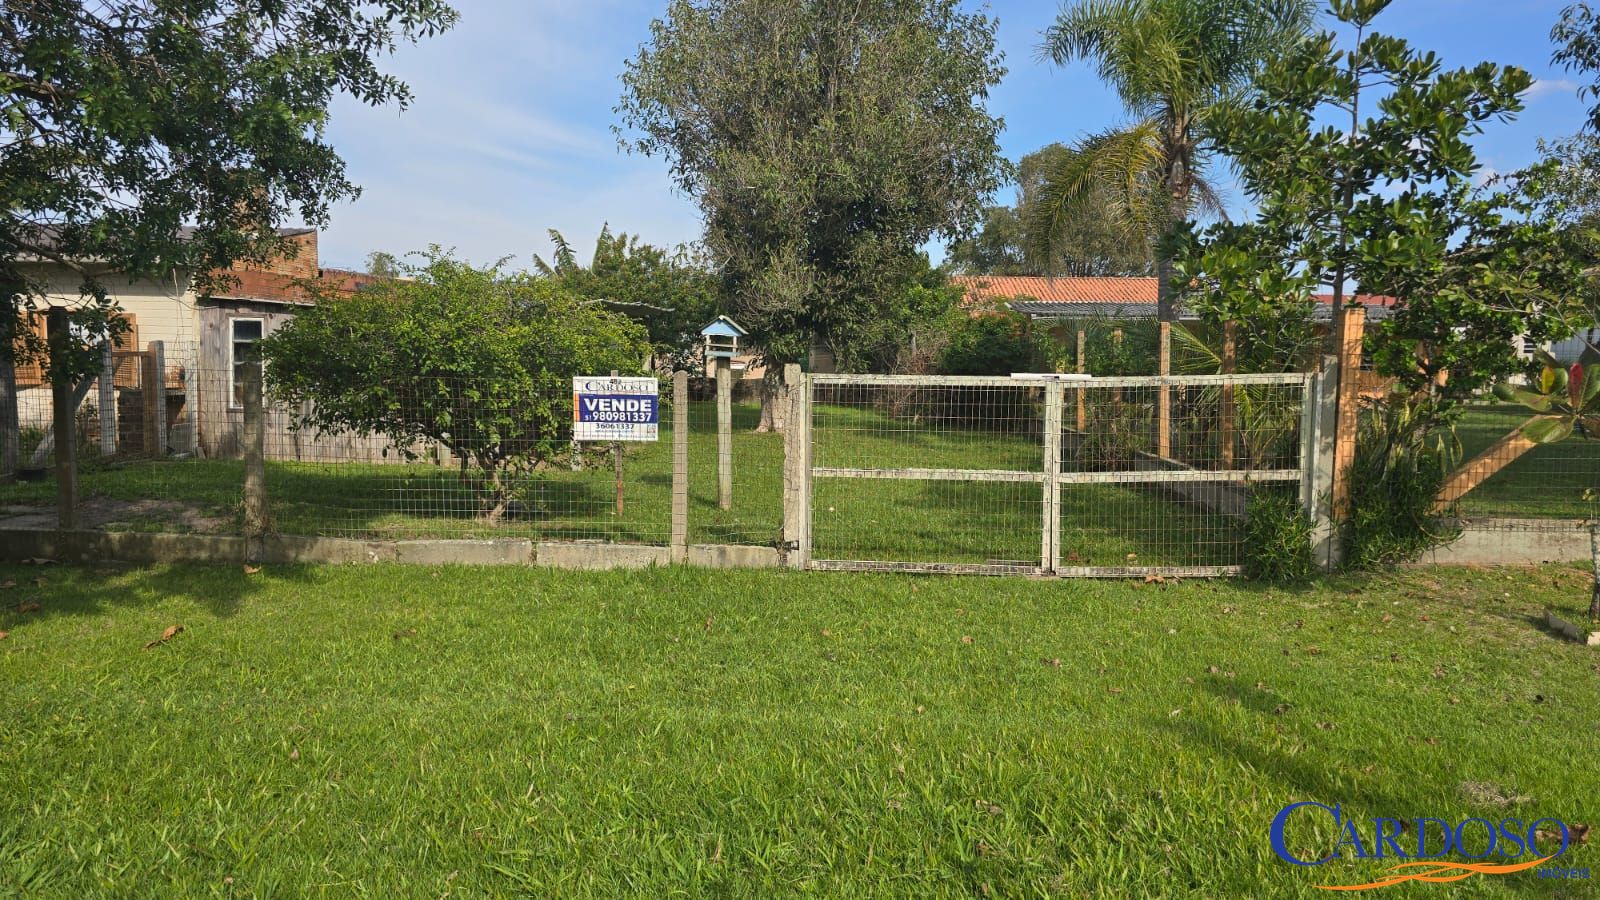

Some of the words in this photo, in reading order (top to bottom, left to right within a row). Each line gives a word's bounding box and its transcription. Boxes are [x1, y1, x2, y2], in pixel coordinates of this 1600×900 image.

[585, 381, 648, 391] CARDOSO
[584, 398, 652, 411] VENDE
[592, 411, 652, 422] 980981337
